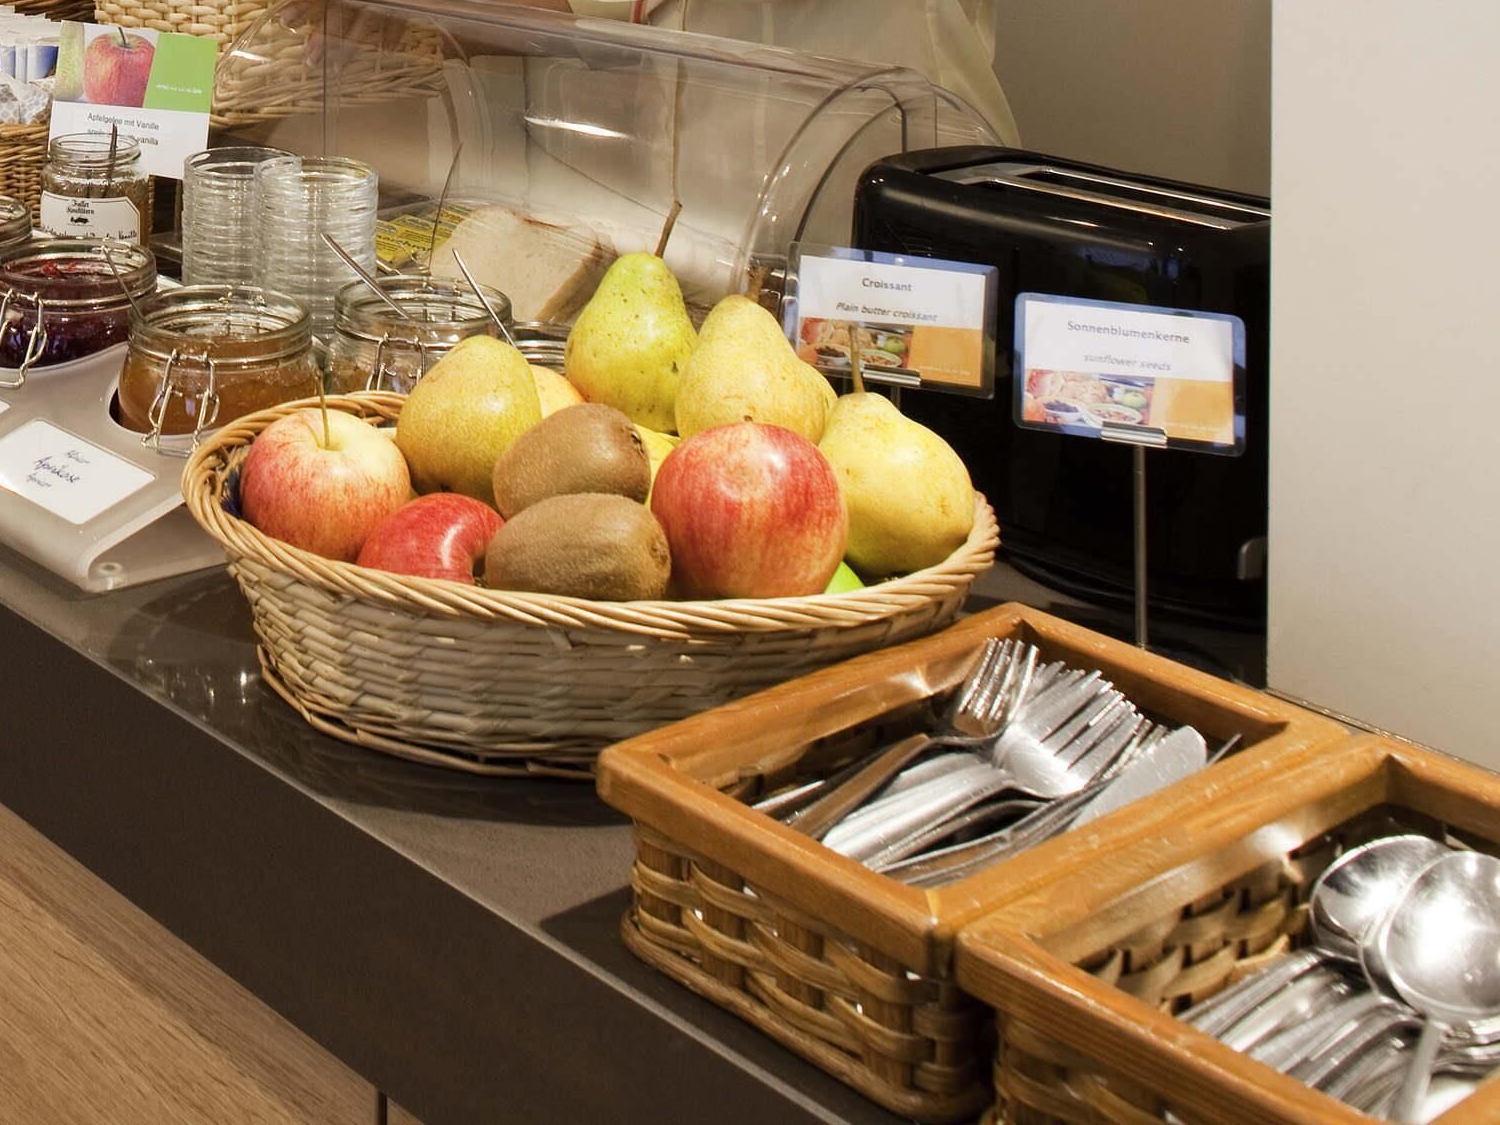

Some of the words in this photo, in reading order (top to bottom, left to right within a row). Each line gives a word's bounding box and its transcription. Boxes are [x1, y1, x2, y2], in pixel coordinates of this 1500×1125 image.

[124, 119, 135, 127] mit
[136, 121, 160, 131] Vanille
[861, 277, 912, 292] Croissant
[836, 301, 858, 313] Plain
[861, 304, 891, 317] butter
[893, 309, 938, 322] croissant
[1067, 320, 1190, 344] Sonnenblumenkerne
[1083, 353, 1136, 368] sunflower
[1140, 359, 1173, 372] seeds
